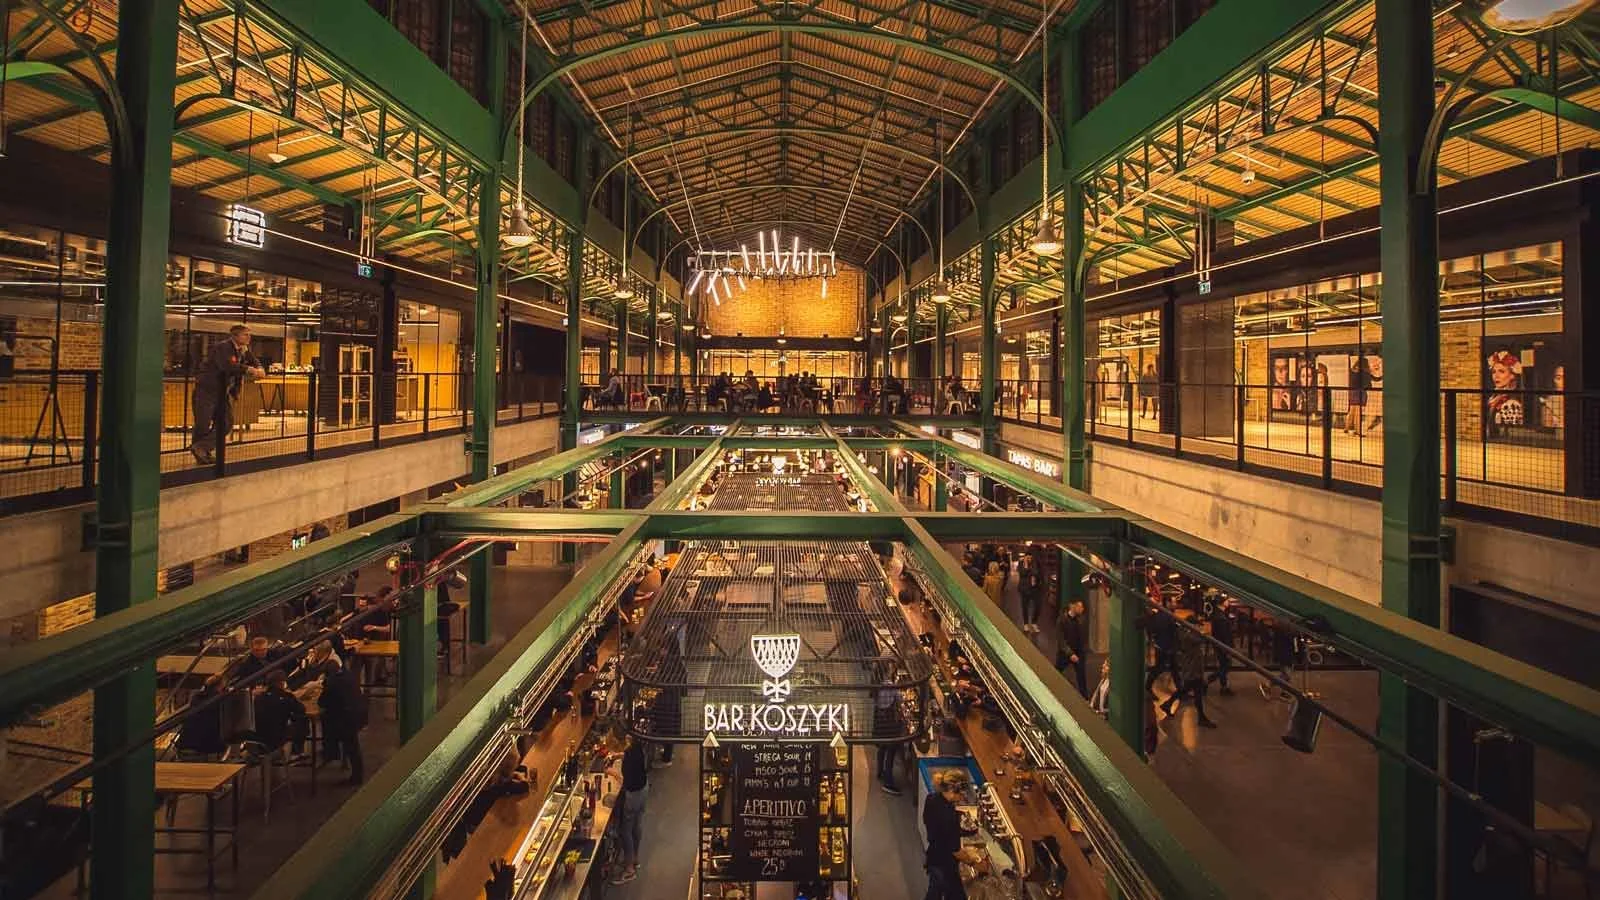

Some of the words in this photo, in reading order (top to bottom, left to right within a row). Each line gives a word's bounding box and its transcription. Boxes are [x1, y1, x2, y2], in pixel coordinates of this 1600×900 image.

[704, 703, 744, 732] BAR
[751, 703, 849, 732] KOSZYKI
[754, 752, 781, 763] STREGA
[784, 752, 801, 763] SOUR
[743, 799, 806, 817] APERITIVO
